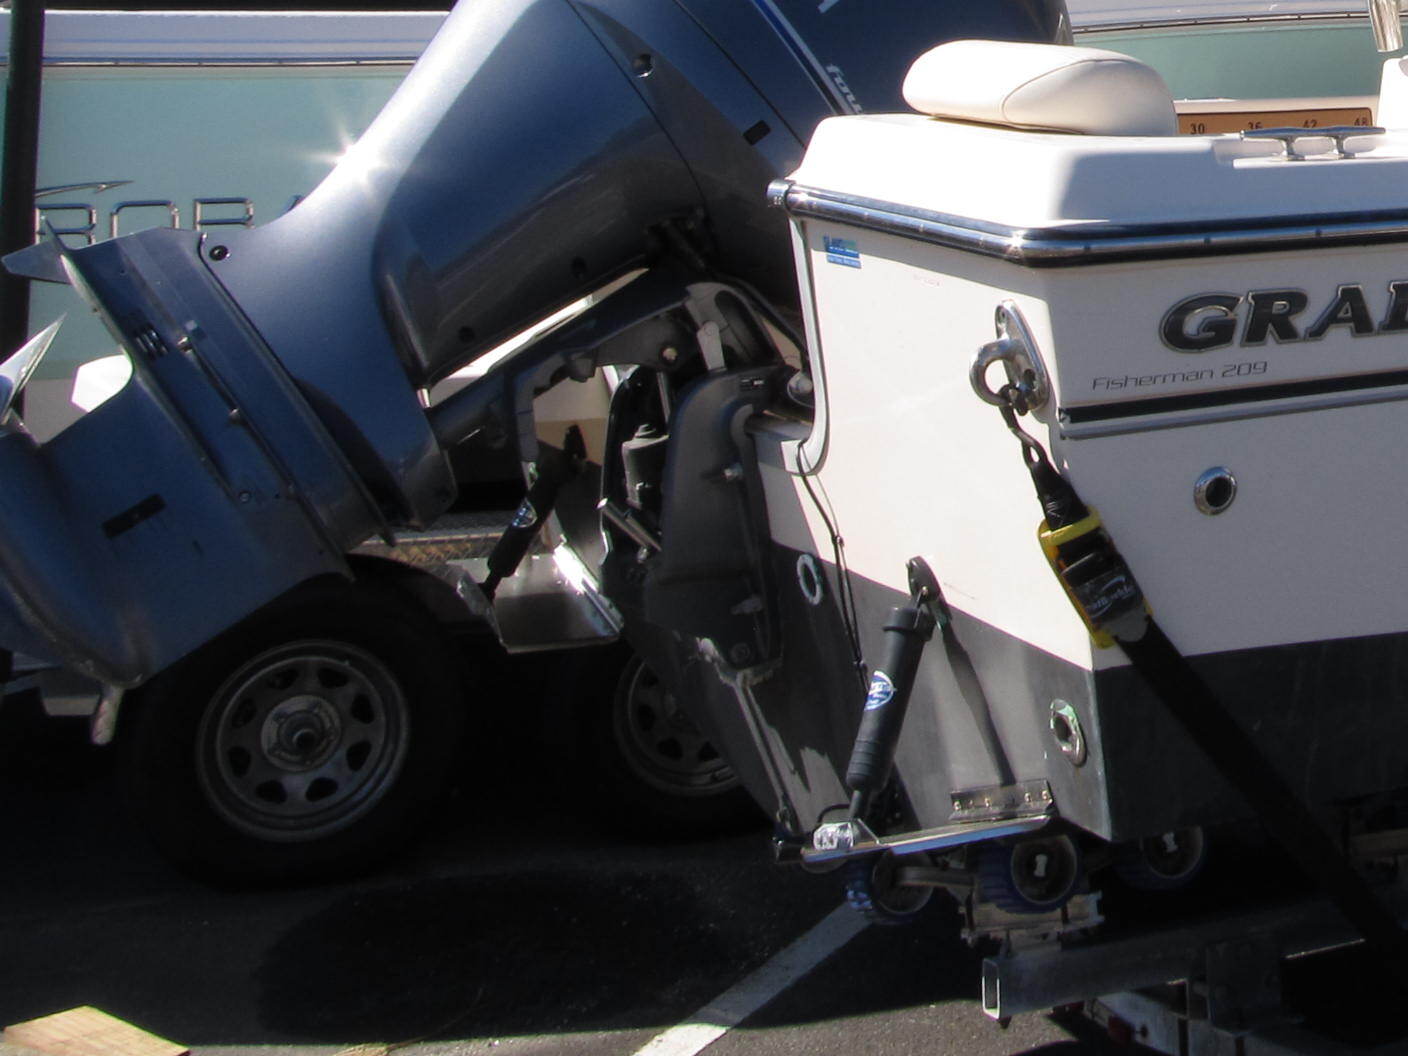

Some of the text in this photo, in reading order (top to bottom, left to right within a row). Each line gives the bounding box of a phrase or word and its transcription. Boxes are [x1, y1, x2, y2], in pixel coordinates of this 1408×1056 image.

[1190, 123, 1205, 135] 30
[1093, 360, 1268, 391] Fisherman 209
